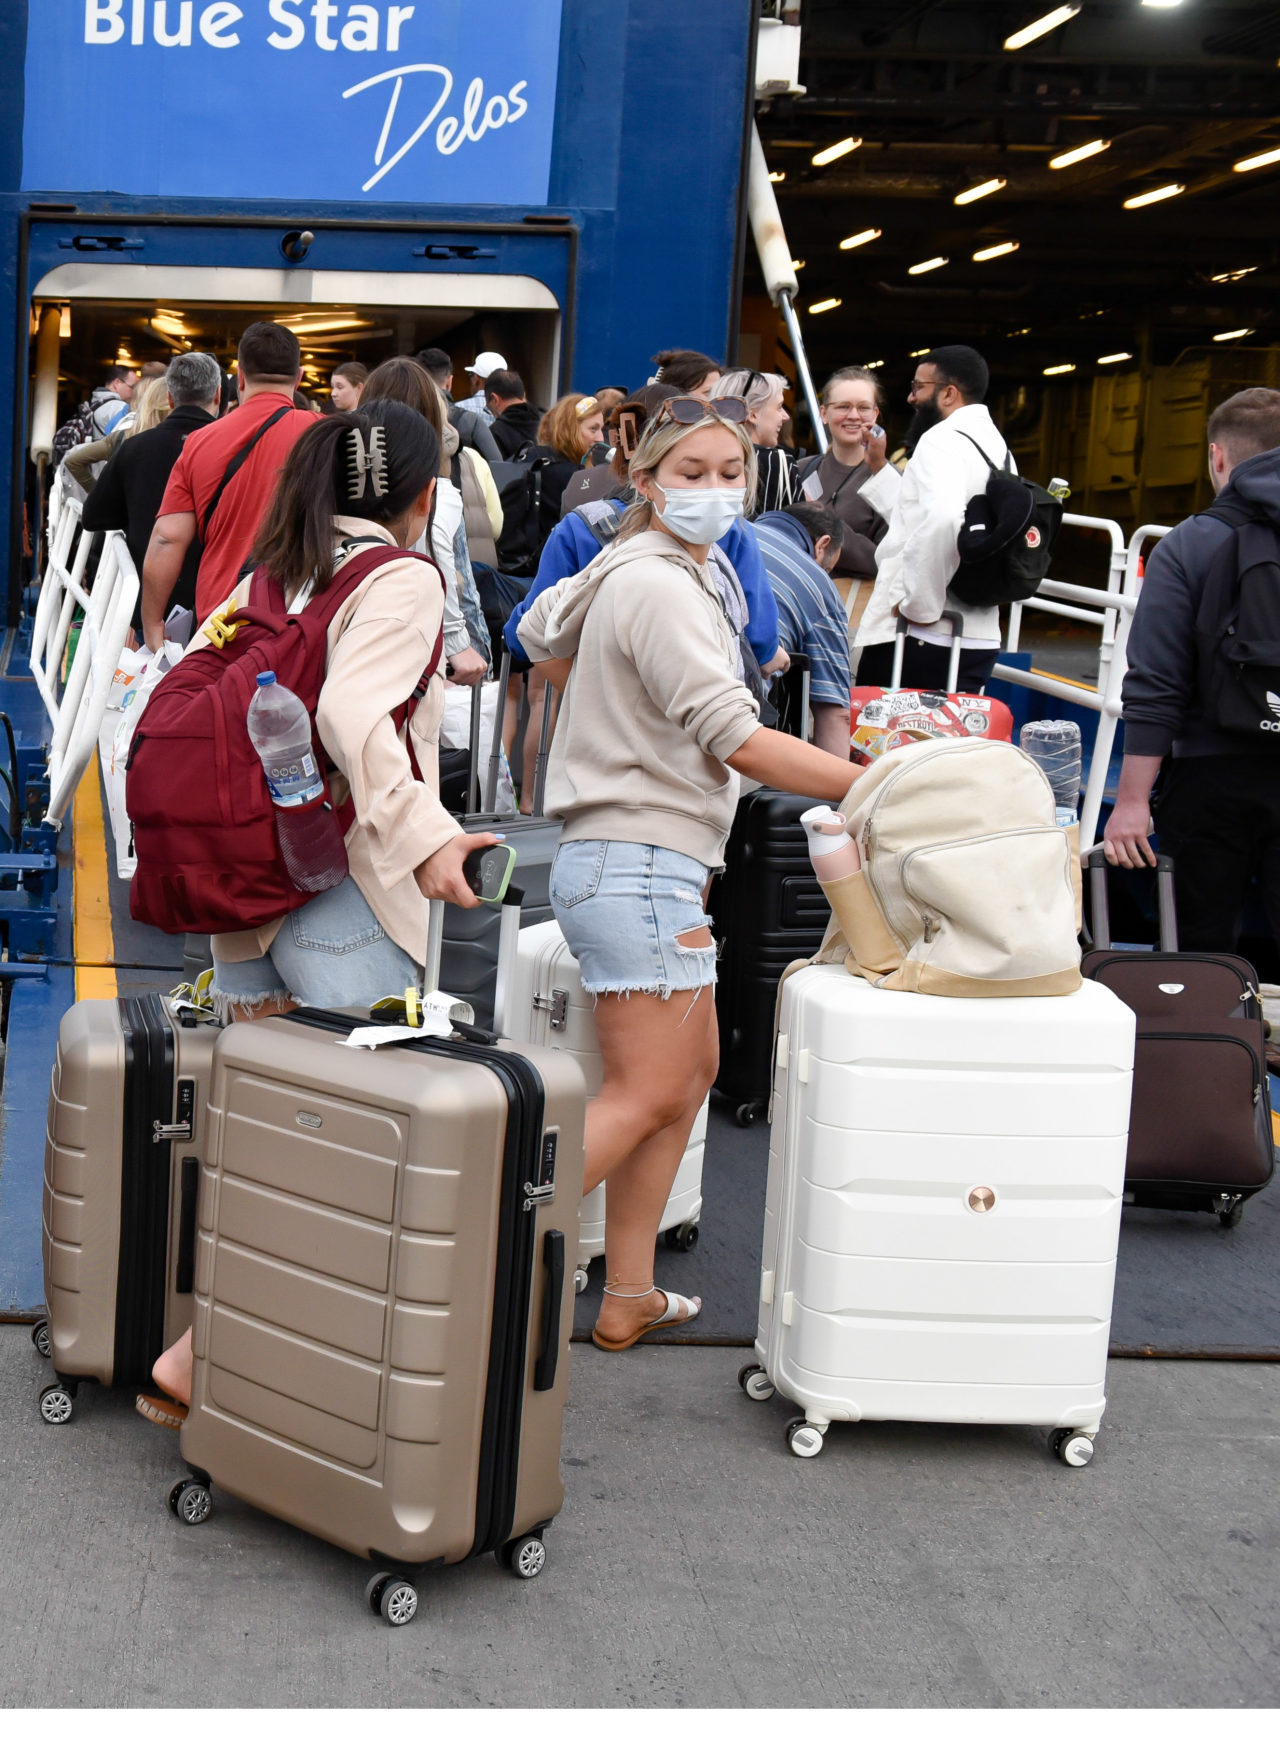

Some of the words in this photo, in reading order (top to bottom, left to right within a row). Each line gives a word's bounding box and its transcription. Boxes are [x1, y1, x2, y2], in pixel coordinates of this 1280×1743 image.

[84, 0, 245, 49] Blue
[266, 0, 416, 51] Star
[342, 63, 529, 192] Delos
